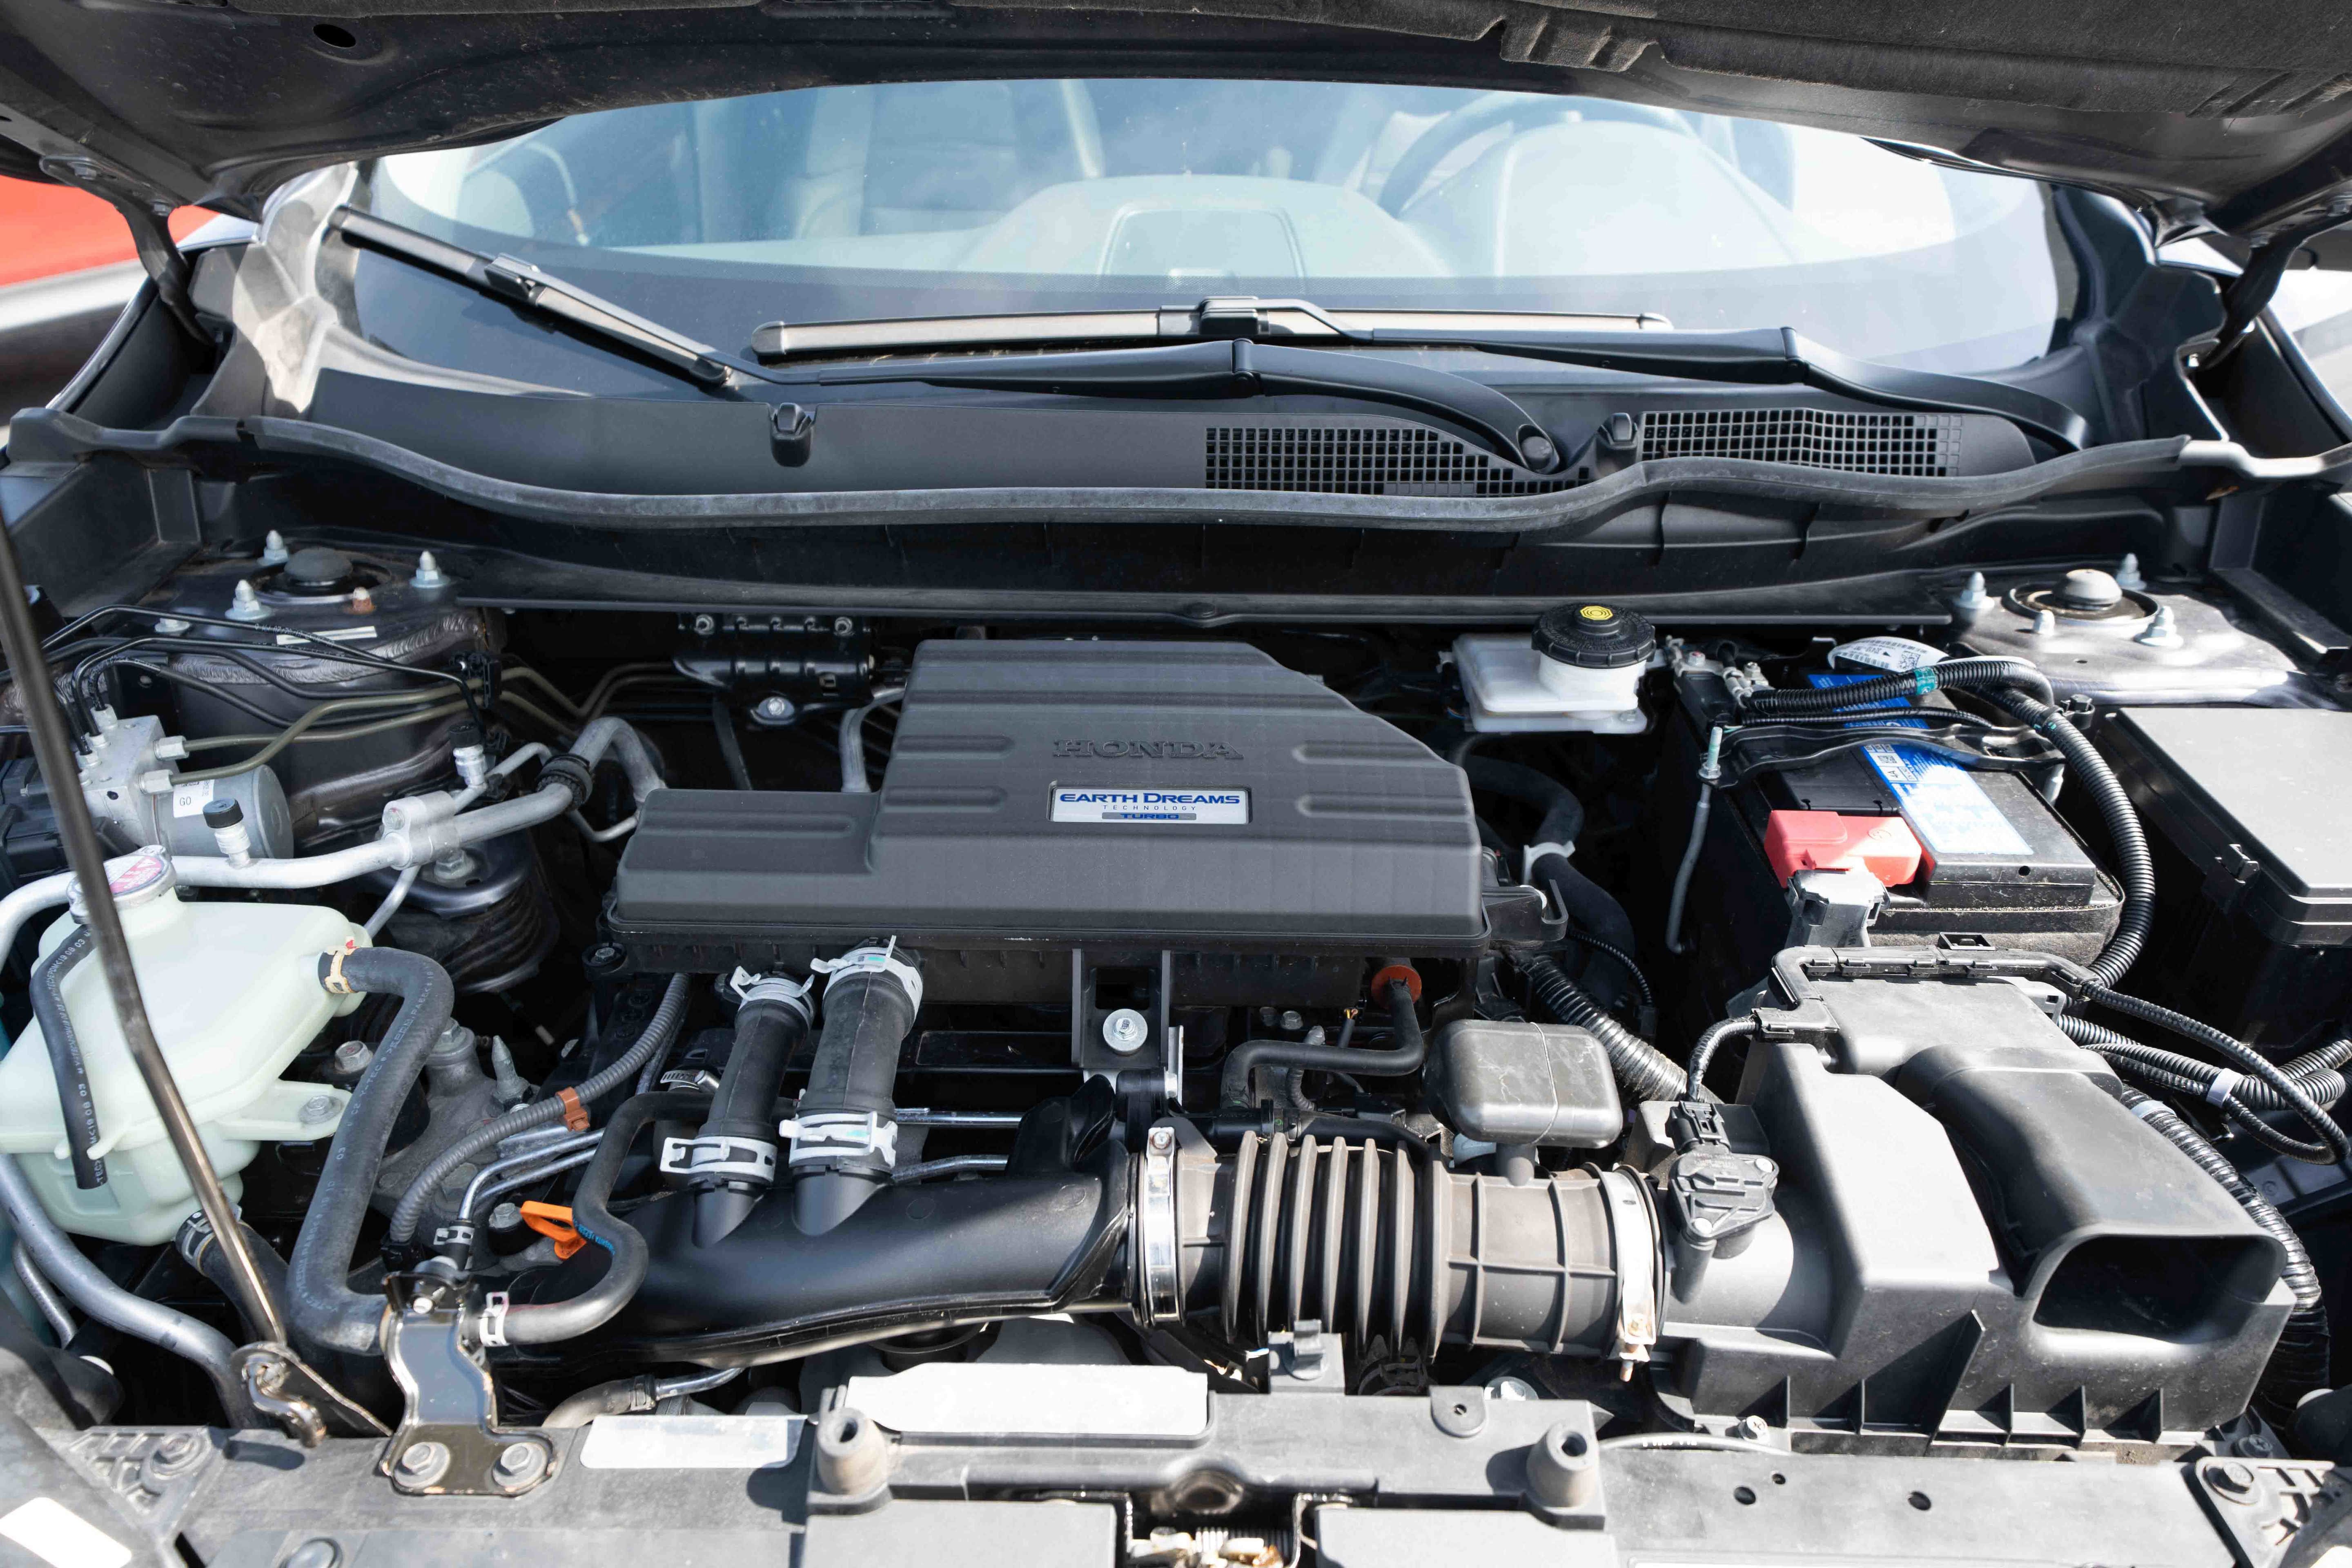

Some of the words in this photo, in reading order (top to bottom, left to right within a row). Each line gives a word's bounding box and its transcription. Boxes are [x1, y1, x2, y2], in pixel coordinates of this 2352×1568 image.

[1053, 739, 1244, 760] HONDA
[1060, 793, 1138, 804] EARTH
[1144, 793, 1240, 804] DREAMS
